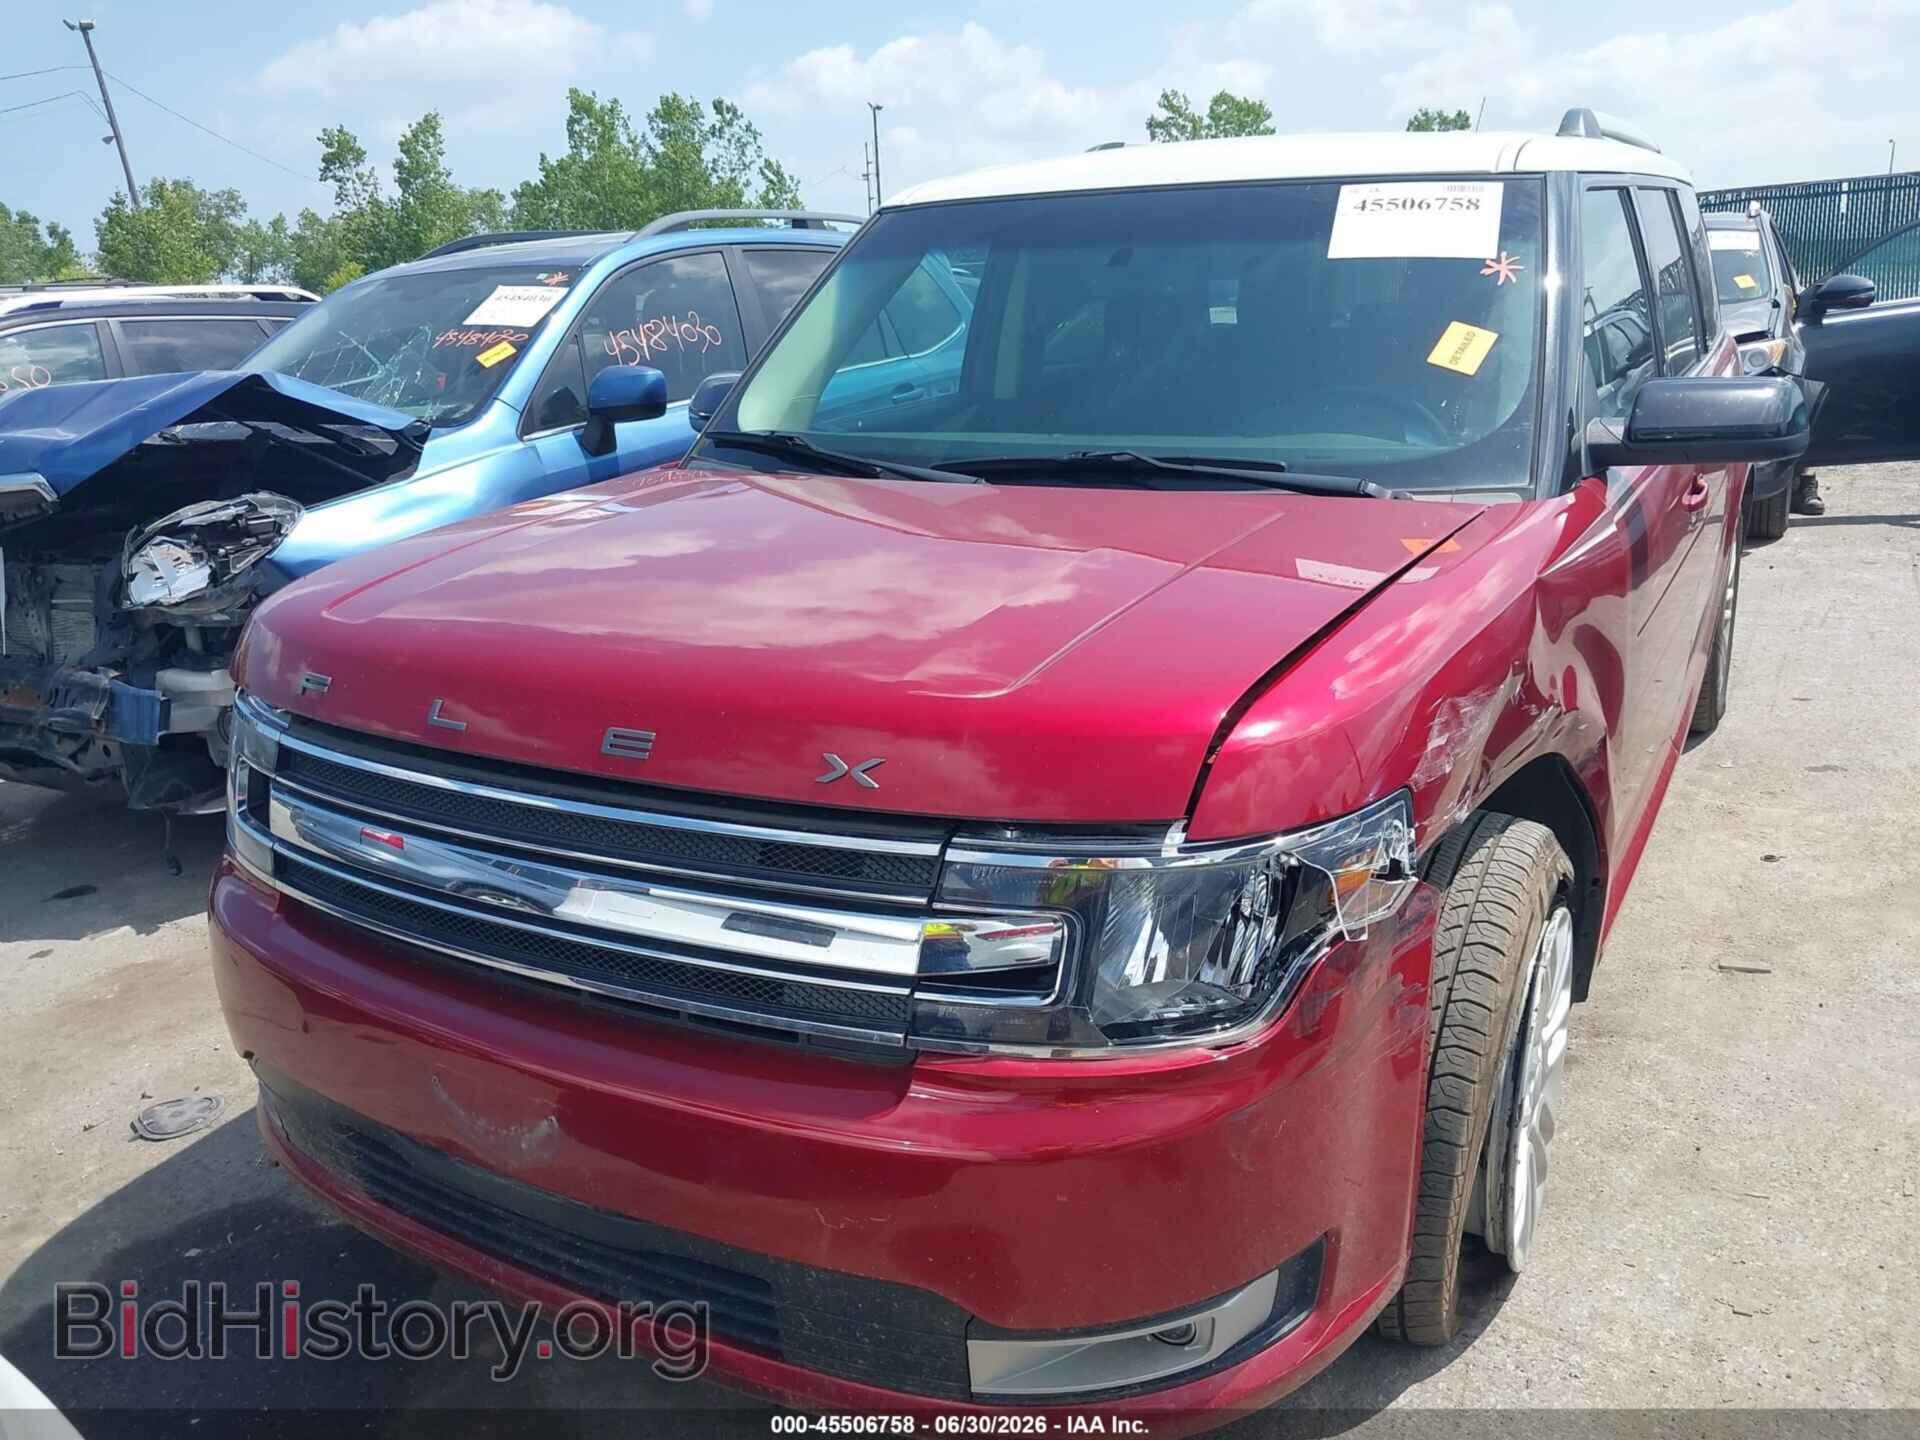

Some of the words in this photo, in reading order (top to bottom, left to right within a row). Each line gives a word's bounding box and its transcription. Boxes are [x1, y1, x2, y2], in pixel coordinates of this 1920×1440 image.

[1353, 197, 1481, 212] 45506758
[604, 311, 722, 367] 45484030
[1448, 331, 1476, 365] DETAILED
[299, 671, 886, 789] FLEX
